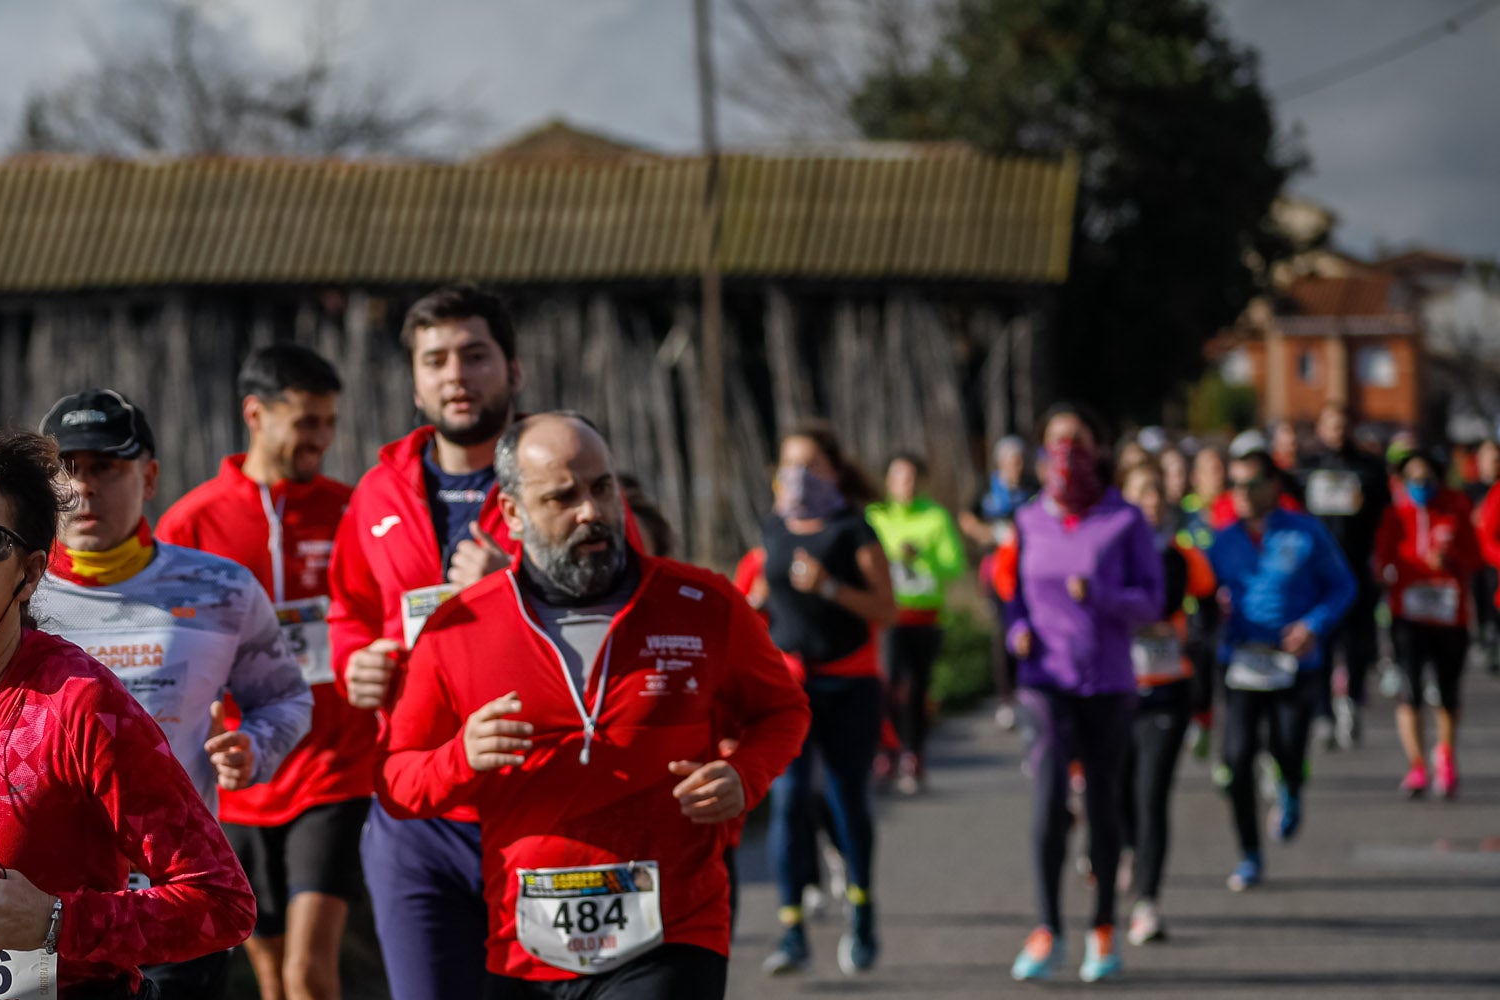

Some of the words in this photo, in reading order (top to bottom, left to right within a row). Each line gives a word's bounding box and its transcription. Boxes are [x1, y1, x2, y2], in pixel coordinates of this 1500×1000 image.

[86, 643, 164, 657] CARRERA
[98, 655, 164, 668] OPULAR
[552, 898, 628, 934] 484
